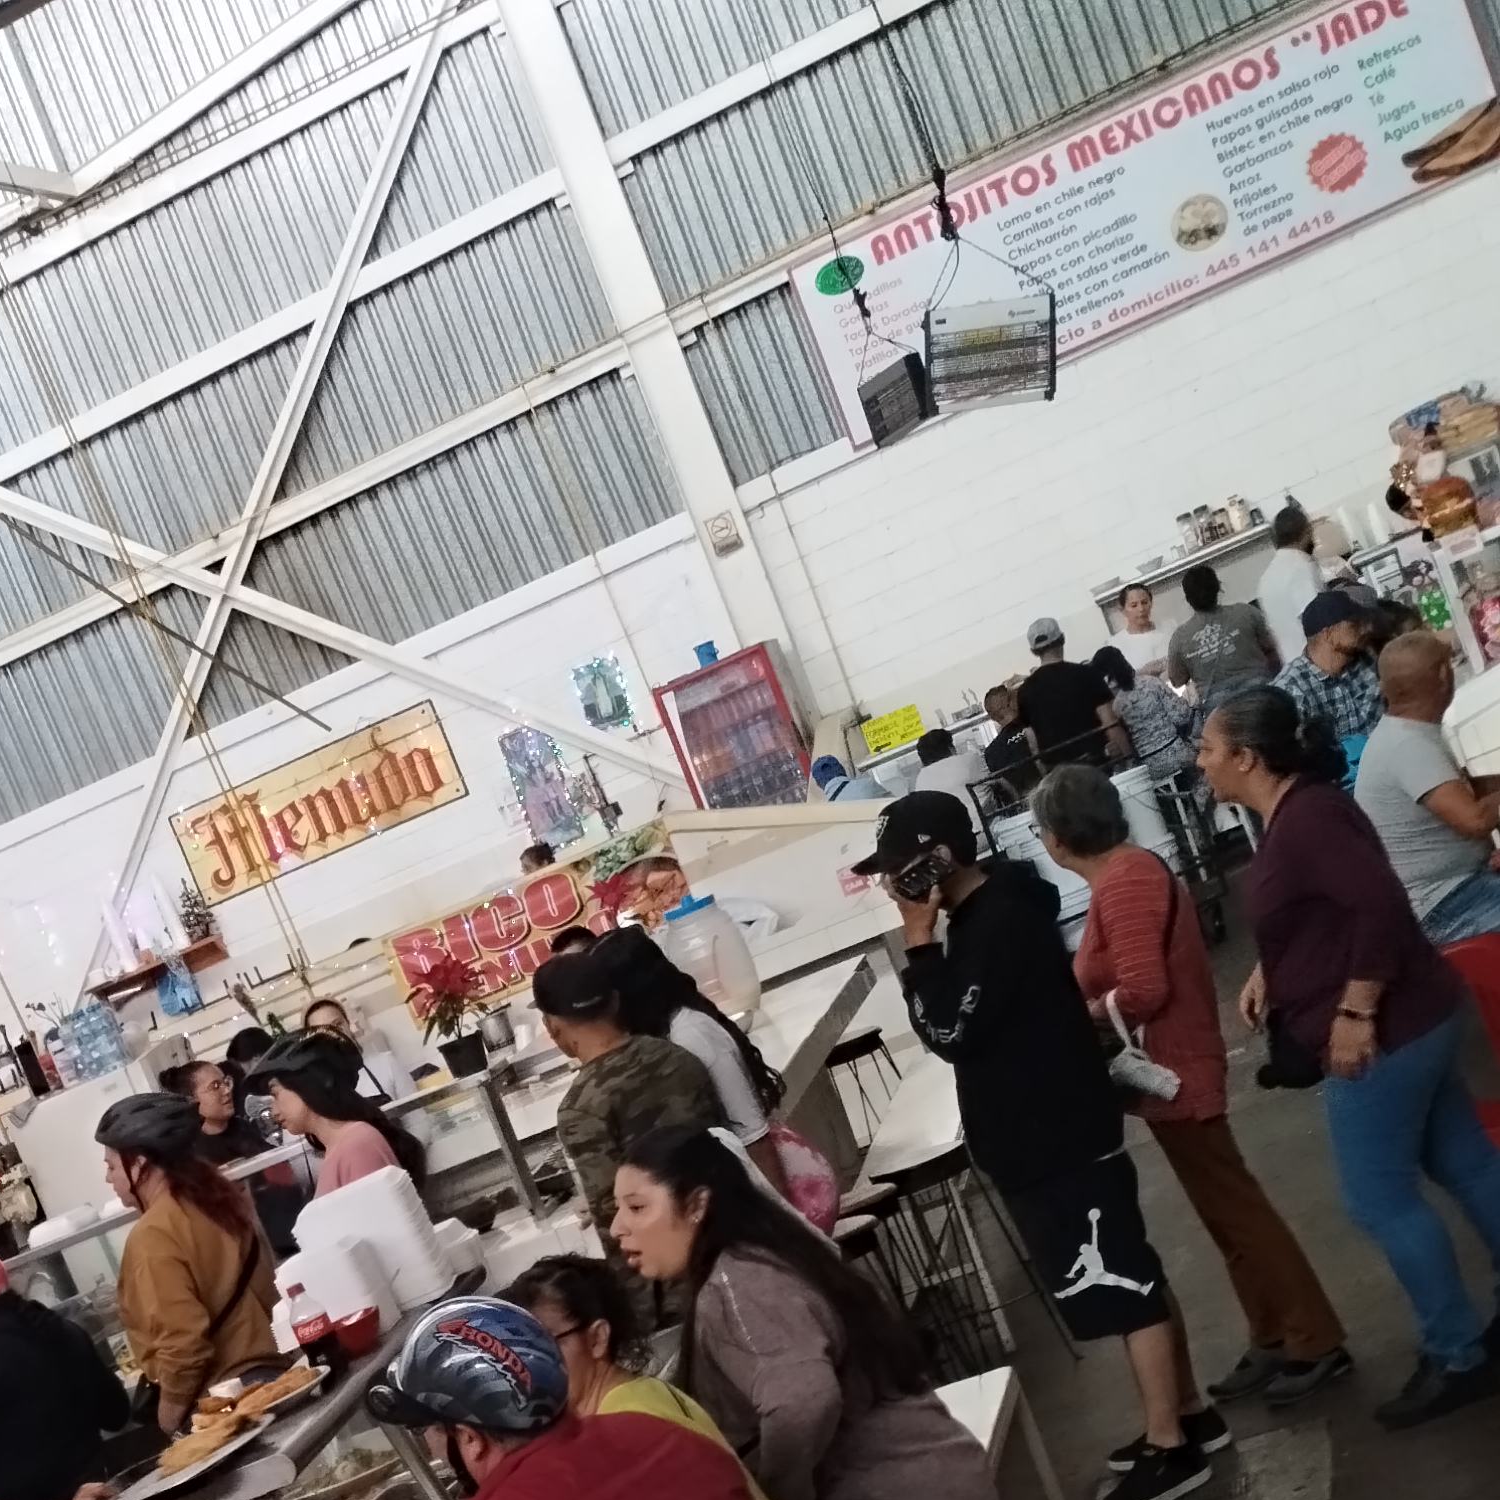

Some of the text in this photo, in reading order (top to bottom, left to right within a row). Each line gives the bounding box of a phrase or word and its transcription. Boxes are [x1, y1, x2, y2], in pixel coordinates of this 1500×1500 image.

[1357, 35, 1421, 70] Refrescos
[1206, 65, 1339, 132] Huevos en salsa roja
[1364, 65, 1395, 88] Café
[1212, 94, 1313, 148] Papas guisadas
[1369, 92, 1384, 107] Té
[1378, 101, 1416, 126] Jugos
[1384, 99, 1464, 143] Agua fresca
[1217, 94, 1353, 163] Bistec en chile negro
[871, 46, 1280, 265] ANTOJITOS MEXICANOS
[1223, 140, 1293, 178] Garbanzos
[997, 167, 1125, 231] Lomo en chile negro
[1230, 173, 1261, 194] Arroz
[1233, 184, 1277, 208] Frijoles
[1003, 189, 1115, 245] Carnitas con rajas
[1237, 193, 1293, 221] Torrezno
[1243, 208, 1293, 236] de papa
[1008, 224, 1077, 260] Chicharrón
[1012, 214, 1137, 275] Papas con picadillo
[1019, 233, 1133, 291] Papas con chorizo
[1058, 244, 1147, 290] en salsa verde
[1084, 251, 1170, 295] con camarón
[1092, 210, 1334, 330] a domicilio: 445 141 4418
[1075, 290, 1124, 316] rellenos
[190, 727, 450, 893] Menudo
[392, 873, 582, 985] RICO
[459, 1324, 532, 1386] HONDA
